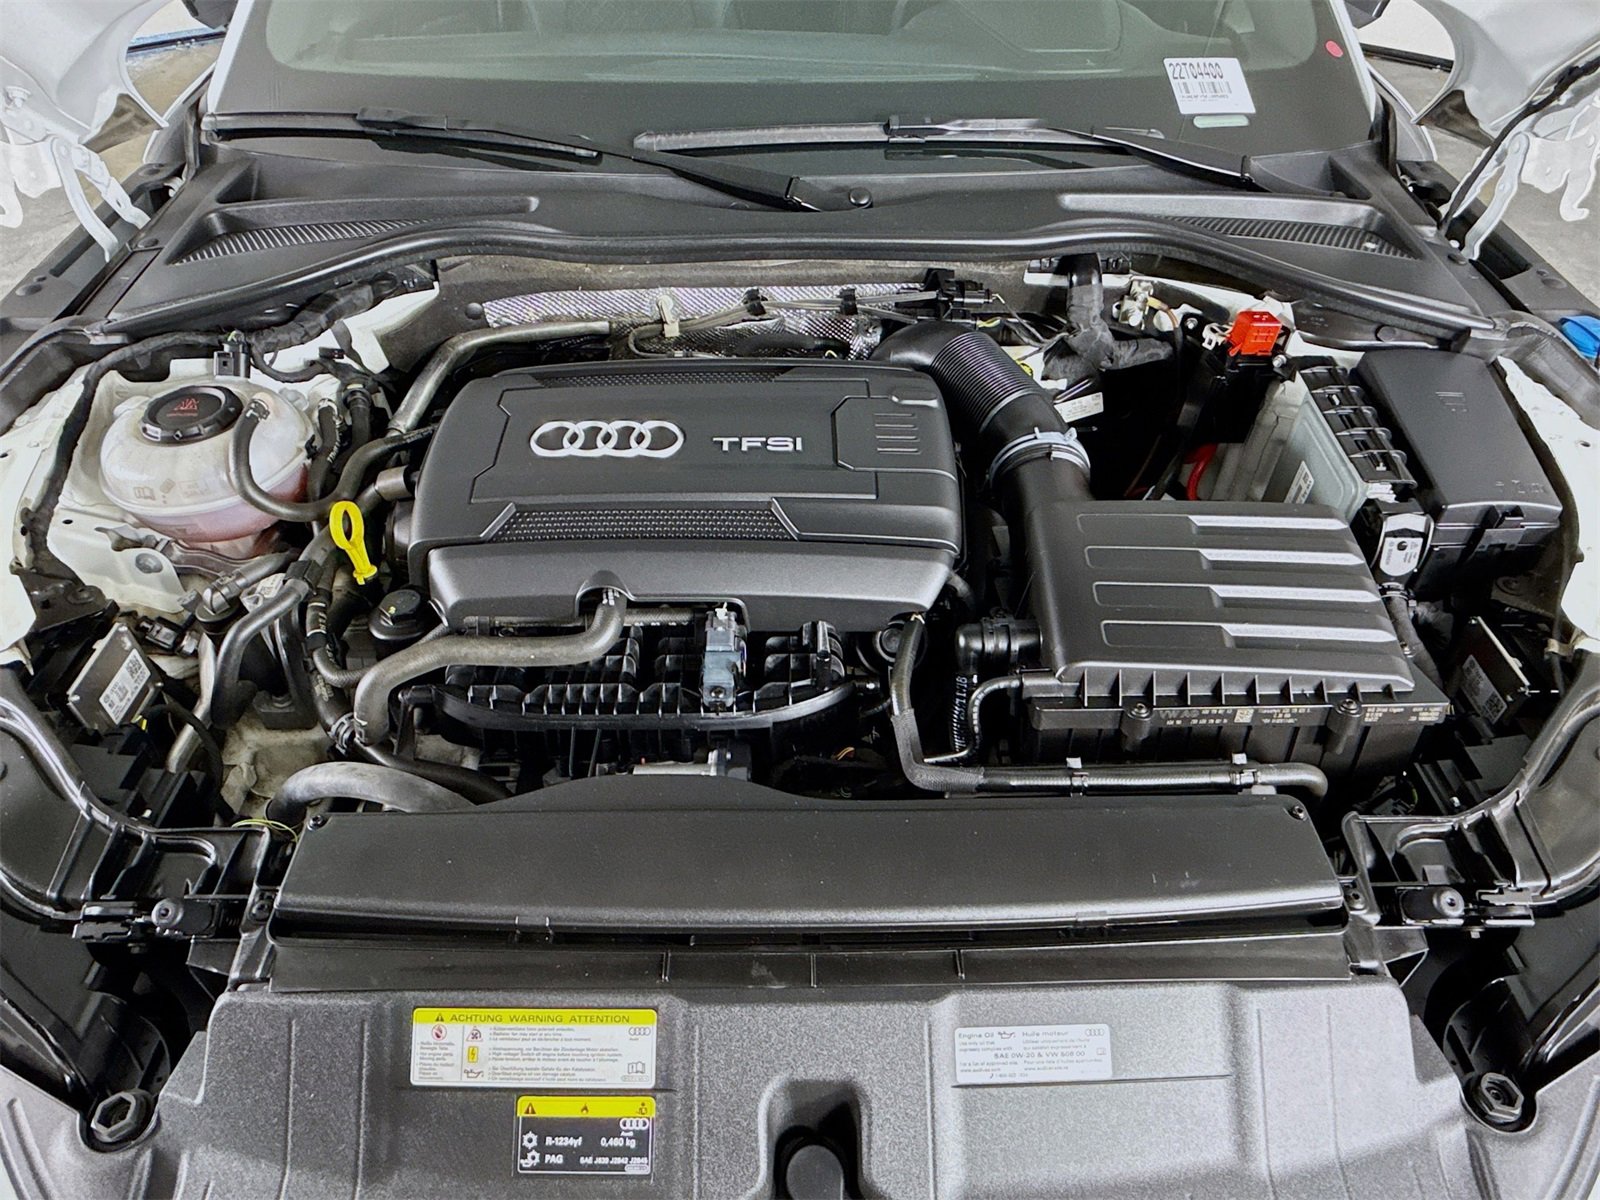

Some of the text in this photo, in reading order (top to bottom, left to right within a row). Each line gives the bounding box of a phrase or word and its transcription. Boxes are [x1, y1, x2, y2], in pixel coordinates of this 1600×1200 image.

[1168, 62, 1224, 80] 22T04400
[712, 436, 802, 452] TFSI
[450, 1015, 630, 1024] ACHTUNG WARNING ATTENTION
[958, 1032, 982, 1040] Engine
[994, 1052, 1009, 1060] SAE
[545, 1136, 583, 1148] R-1234yf
[625, 1137, 637, 1149] kg
[544, 1153, 564, 1164] PAG
